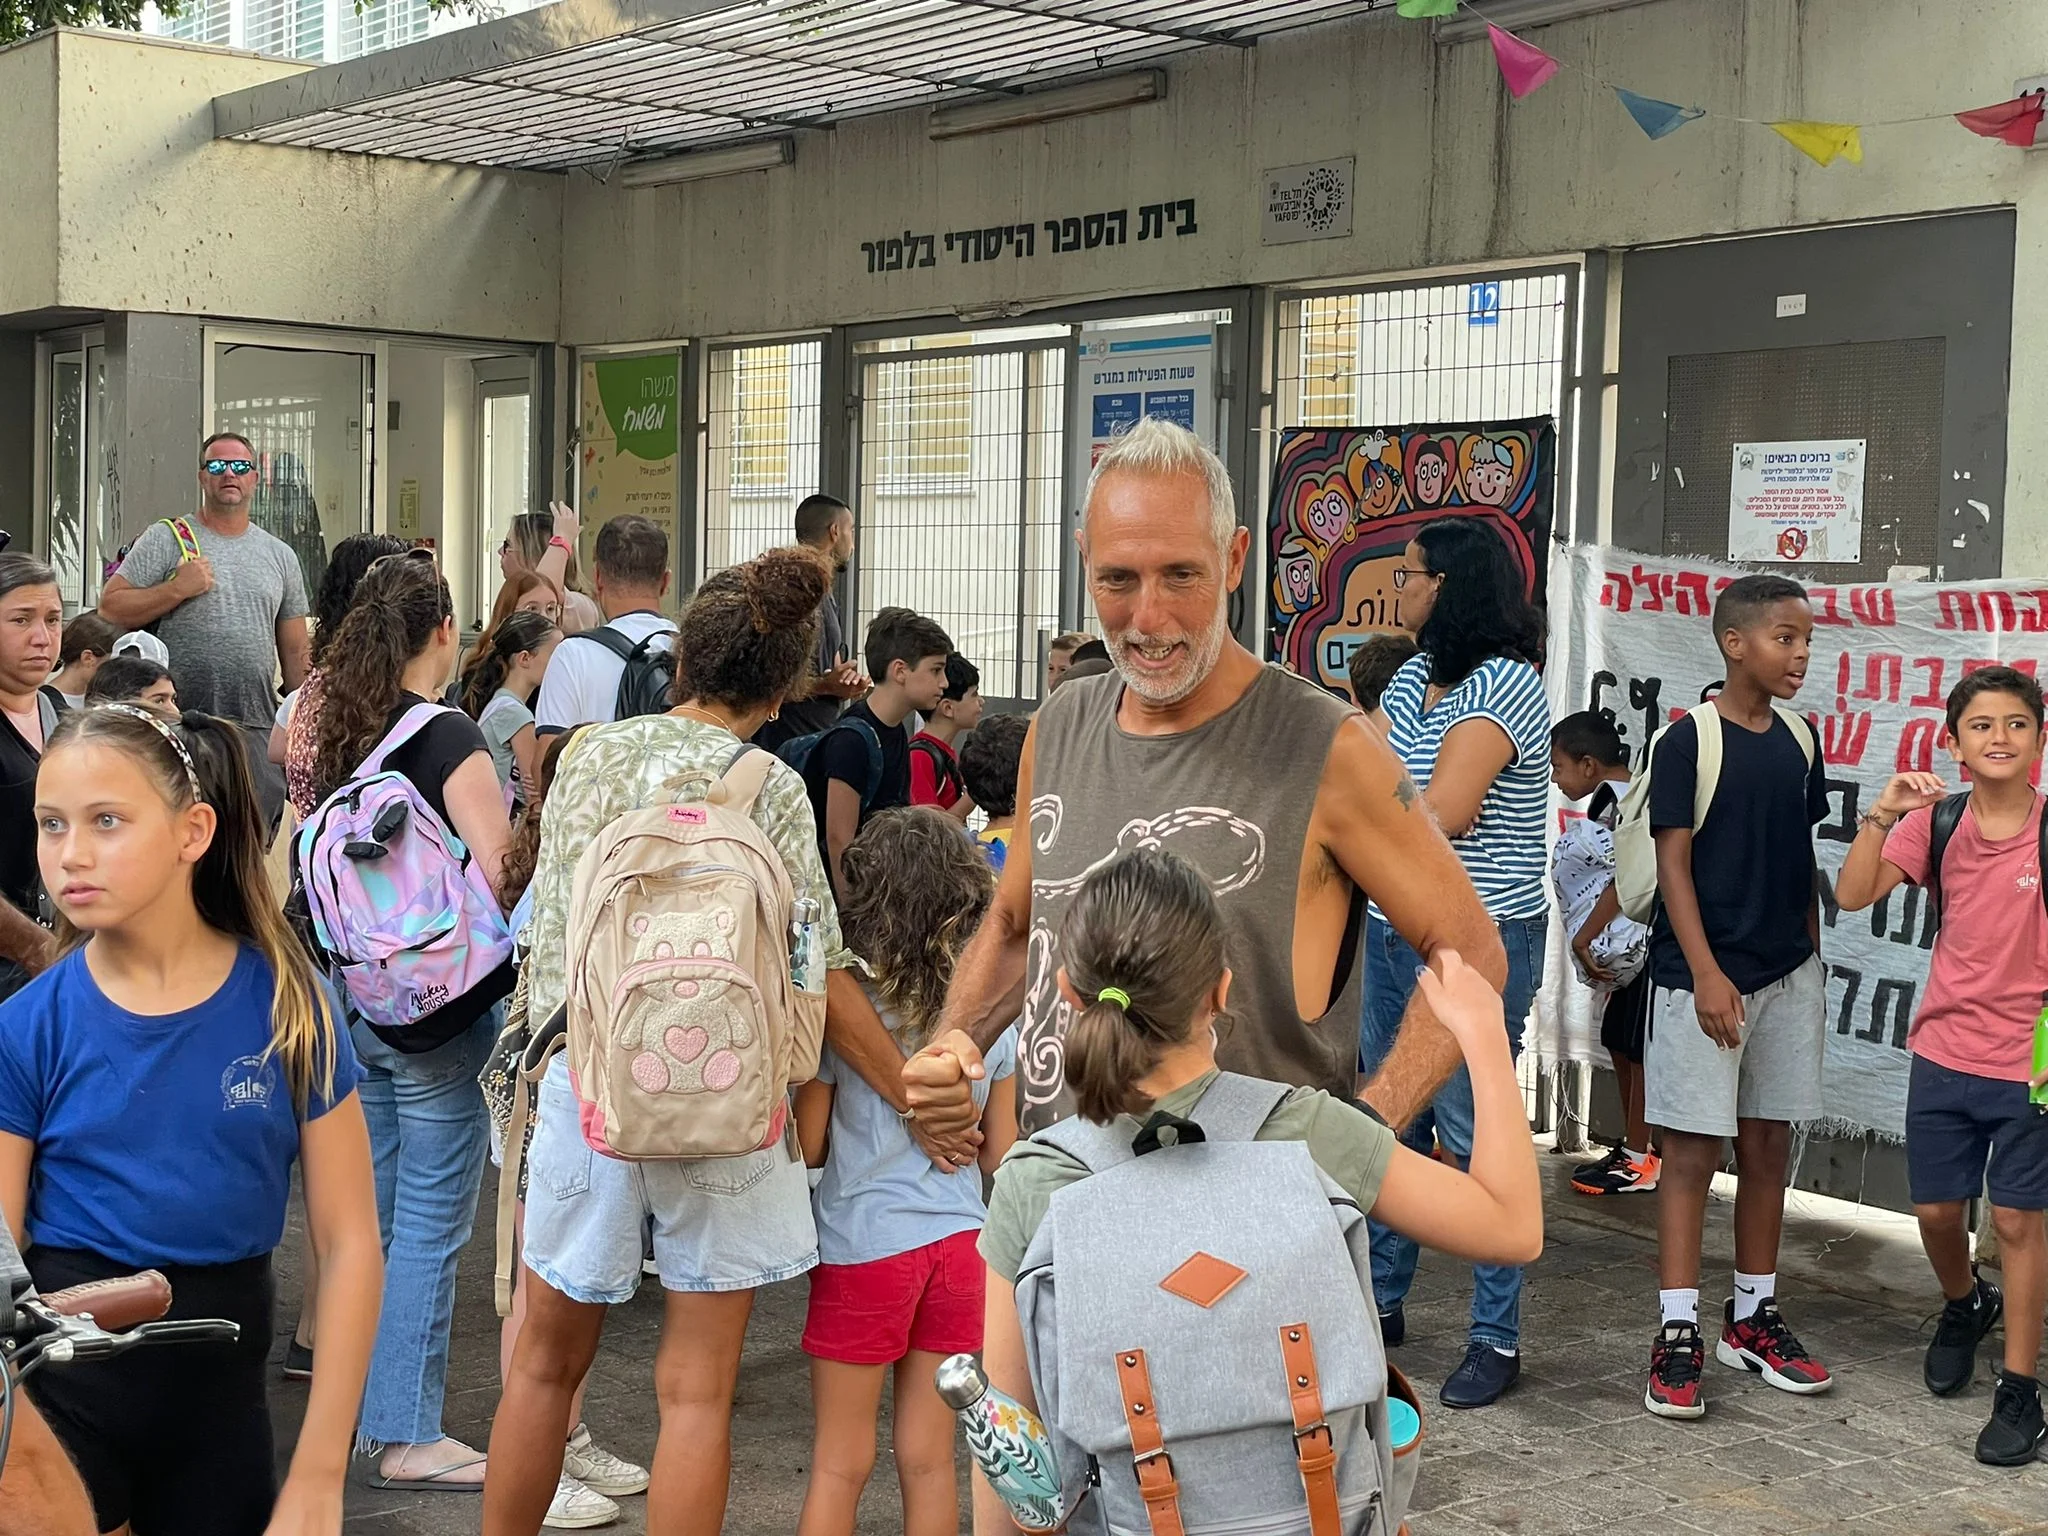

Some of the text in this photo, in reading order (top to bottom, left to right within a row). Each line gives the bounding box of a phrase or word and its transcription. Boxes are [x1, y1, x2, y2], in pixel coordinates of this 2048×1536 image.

[1280, 191, 1291, 201] TEL
[1292, 189, 1302, 199] תל
[1274, 212, 1291, 222] YAFO
[860, 198, 1197, 273] בית הספר היסודי בלפור
[1471, 286, 1498, 318] 12
[1094, 366, 1195, 385] שעות הפעילות במגרש
[641, 375, 676, 398] משהו
[622, 403, 667, 432] משמח
[1764, 454, 1797, 464] הבאים!
[1800, 453, 1831, 463] ברוכים
[1765, 502, 1772, 510] כל
[1773, 502, 1781, 510] על
[411, 984, 449, 1006] Mickey
[417, 995, 447, 1014] MOUSE
